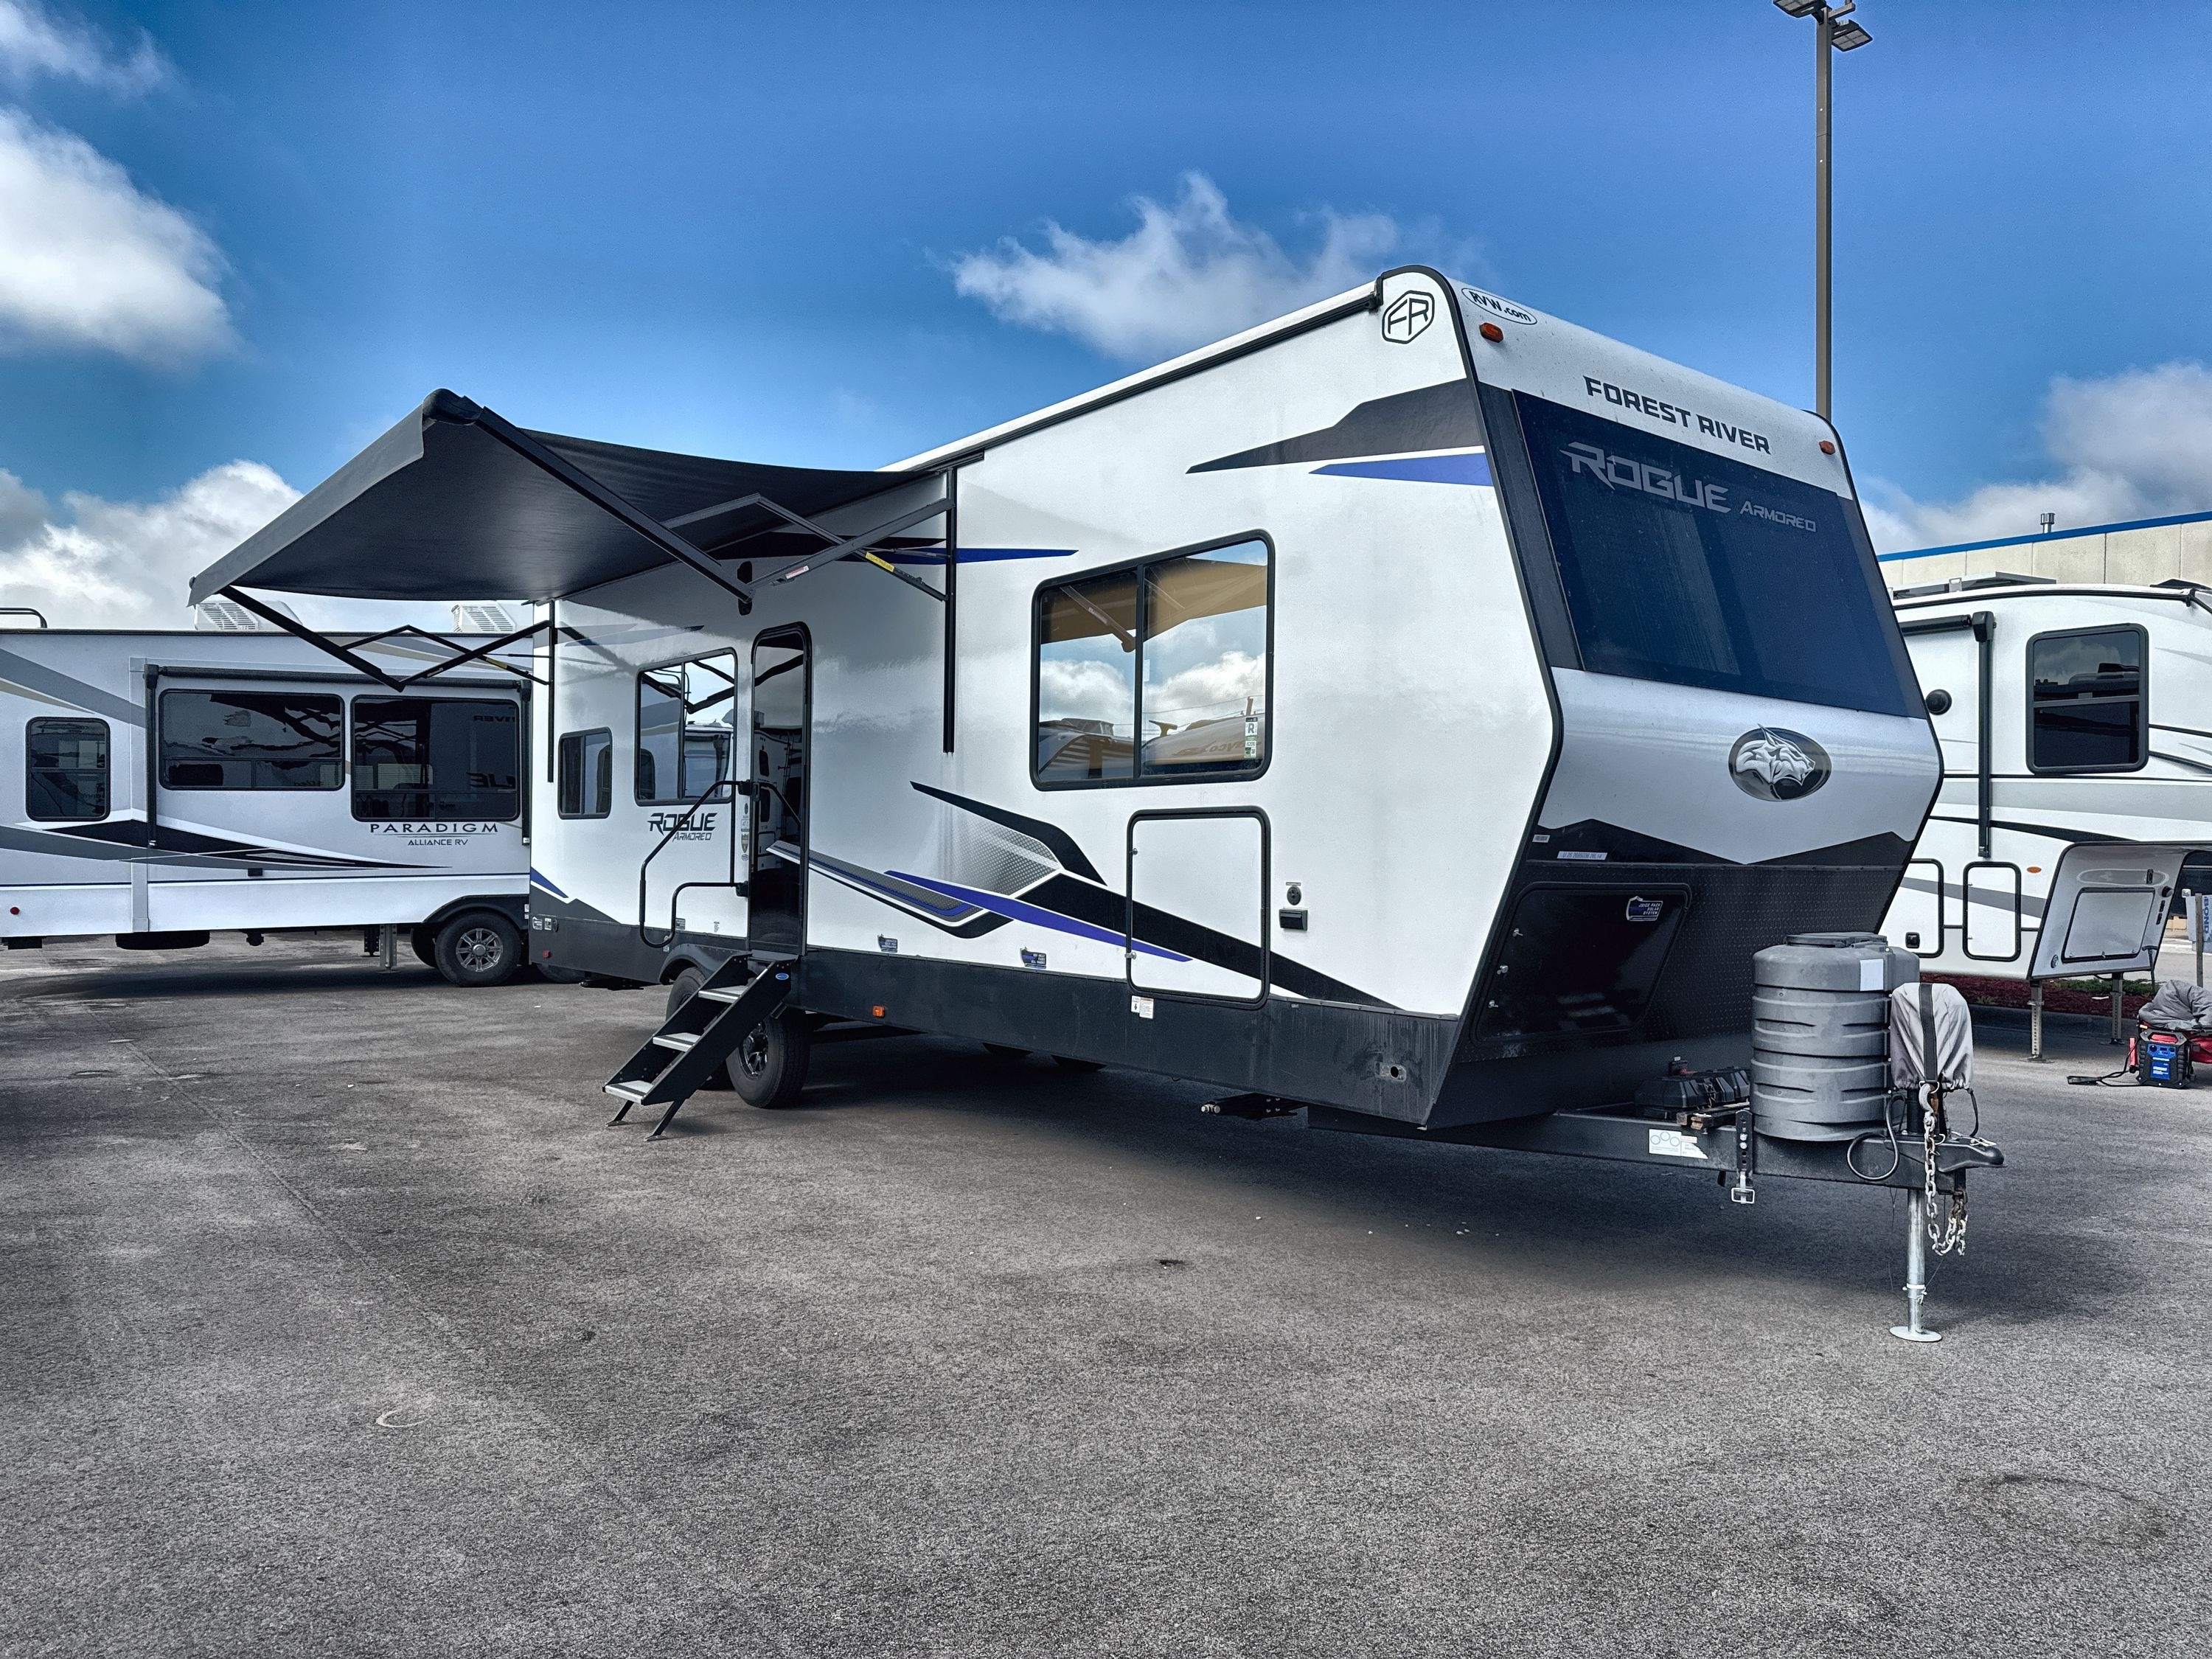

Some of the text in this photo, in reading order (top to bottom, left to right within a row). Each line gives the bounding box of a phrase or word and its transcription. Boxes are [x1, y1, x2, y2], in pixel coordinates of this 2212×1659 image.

[1469, 291, 1532, 322] RVW.com
[1583, 375, 1772, 455] FOREST RIVER
[1559, 441, 1817, 533] ROGUE ARMORED
[1248, 723, 1255, 734] R
[370, 823, 498, 833] PARADIGM
[647, 813, 717, 836] ROGUE
[672, 831, 712, 842] ARMORED
